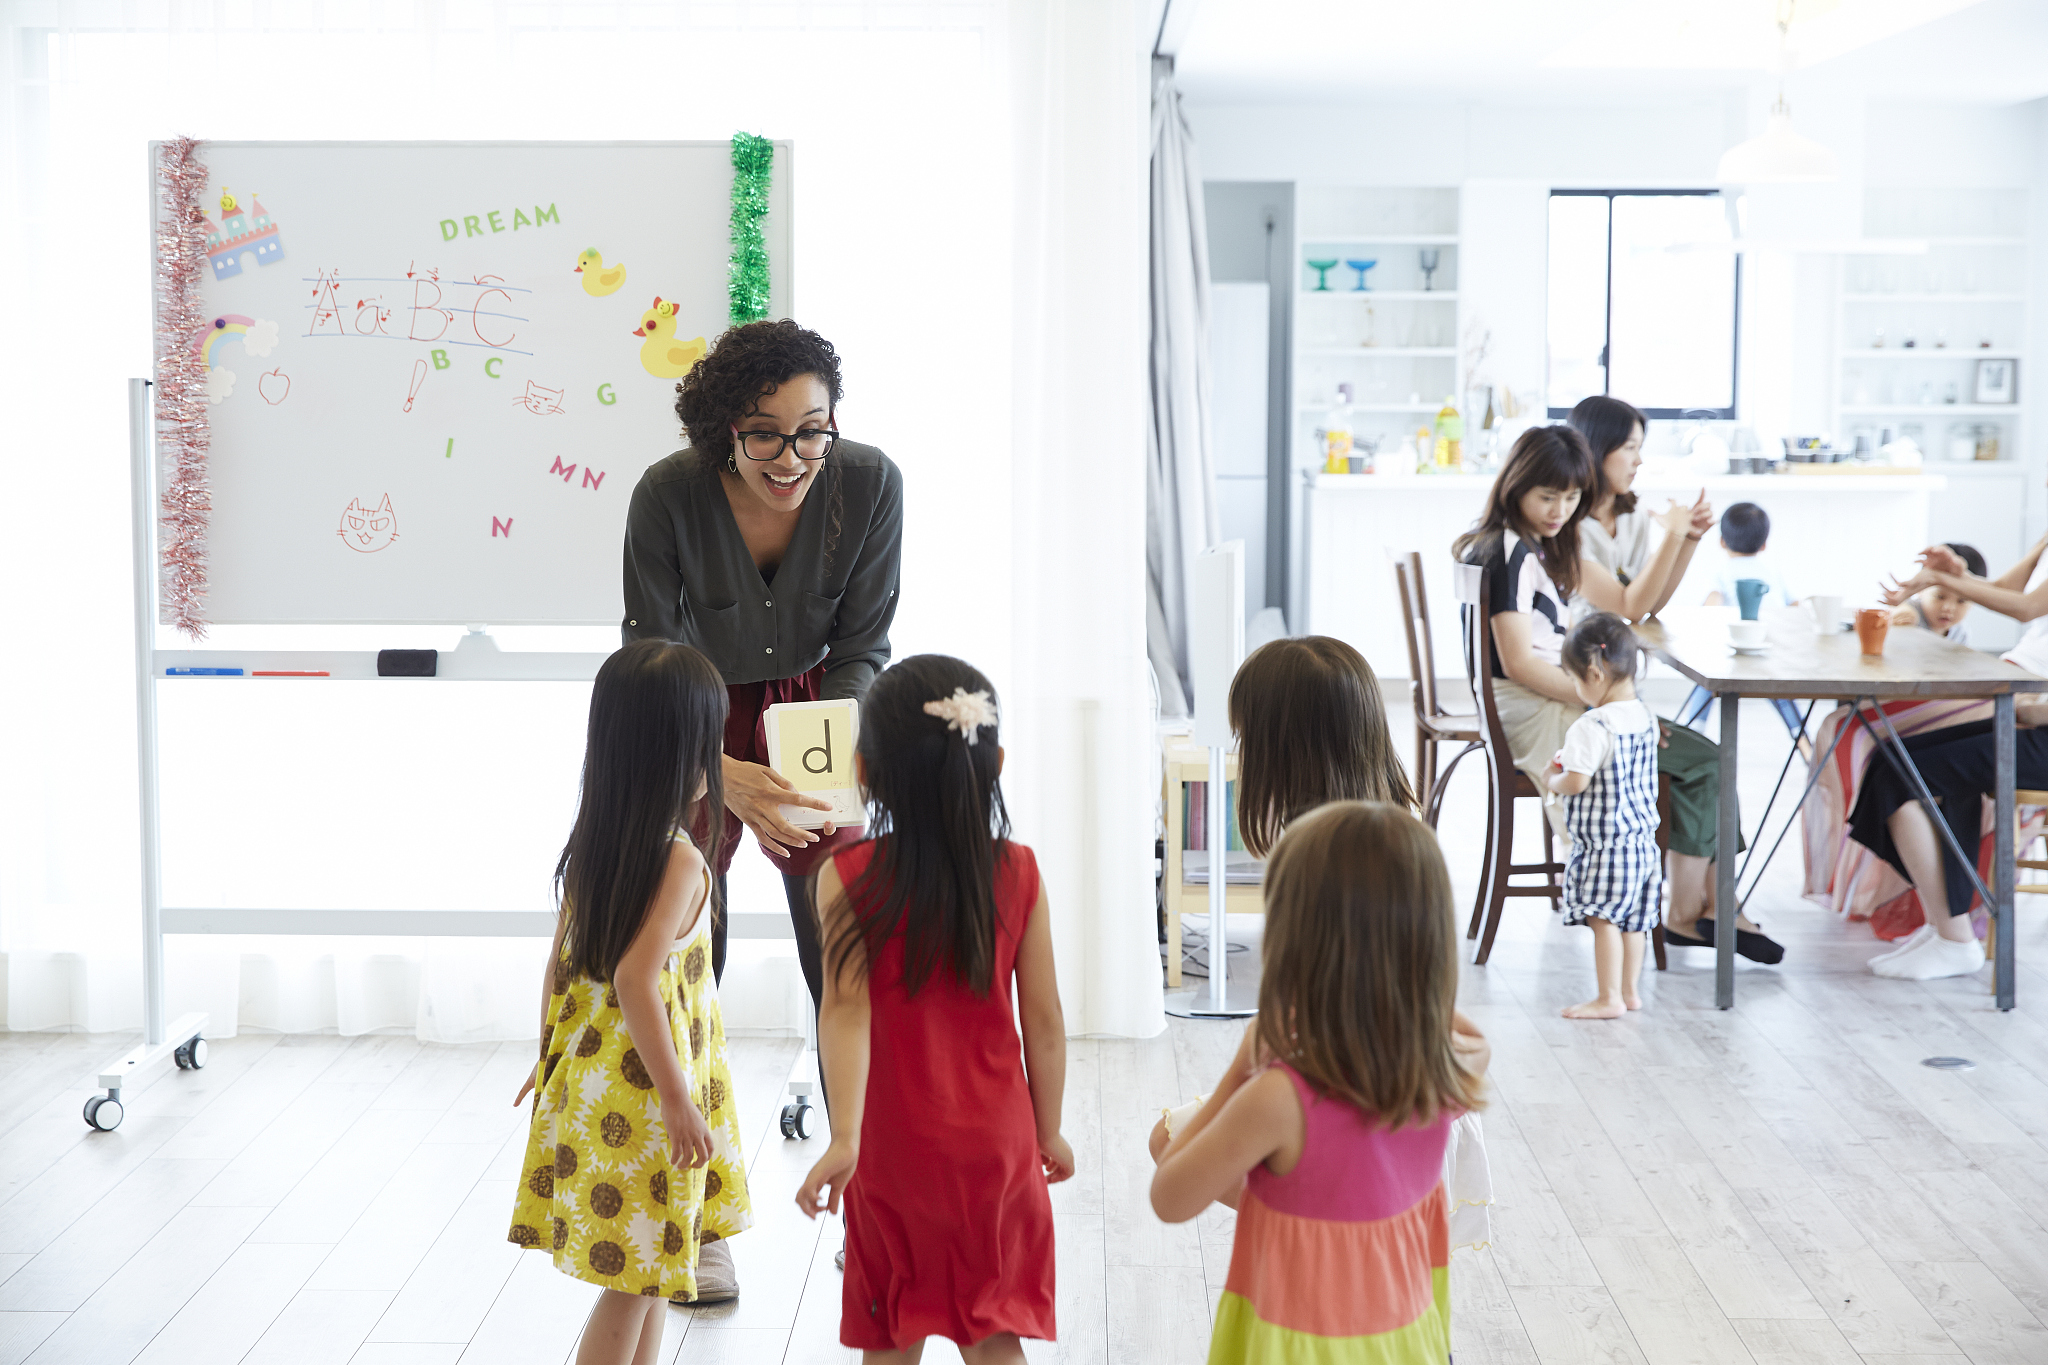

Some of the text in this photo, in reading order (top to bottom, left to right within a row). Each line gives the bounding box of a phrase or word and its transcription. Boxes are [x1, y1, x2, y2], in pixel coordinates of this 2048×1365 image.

[440, 203, 560, 241] DREAM
[431, 349, 503, 378] B C
[597, 383, 616, 405] G
[492, 516, 513, 538] N
[802, 719, 833, 774] d
